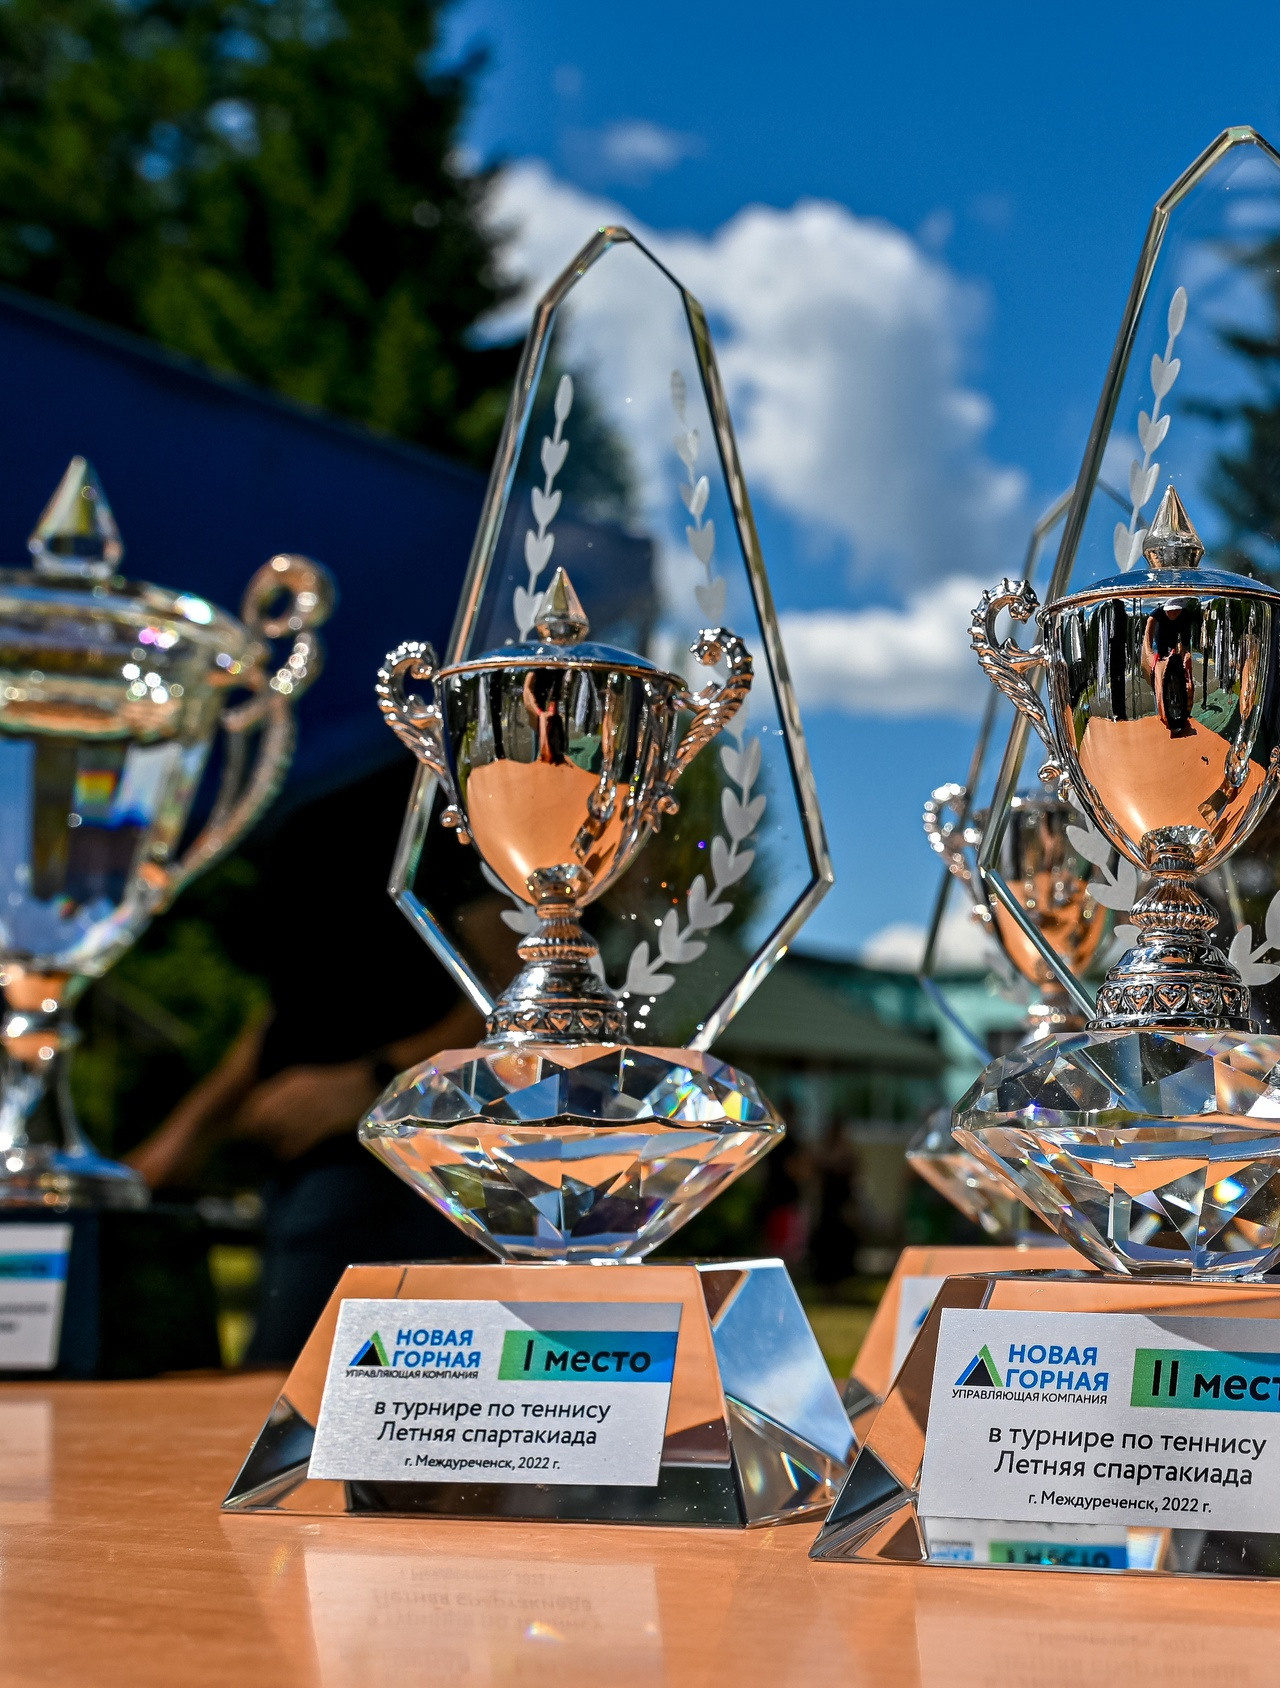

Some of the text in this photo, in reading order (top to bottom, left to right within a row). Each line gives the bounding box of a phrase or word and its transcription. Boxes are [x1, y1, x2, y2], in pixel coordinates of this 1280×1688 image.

[395, 1329, 474, 1347] НОВАЯ
[391, 1350, 482, 1368] ГОРНАЯ
[523, 1339, 651, 1374] I место
[1007, 1343, 1098, 1366] НОВАЯ
[345, 1369, 479, 1380] УПРАВЛЯЮЩАЯ КОМПАНИЯ
[1005, 1368, 1109, 1392] ГОРНАЯ
[1151, 1360, 1179, 1397] II
[951, 1389, 1108, 1405] УПРАВЛЯЮЩАЯ КОМПАНИЯ
[374, 1402, 611, 1423] в турнире по теннису
[377, 1421, 597, 1448] Летняя спартакиада
[988, 1428, 1267, 1460] в турнире по теннису
[404, 1455, 561, 1471] г. Междуреченск, 2022 г.
[994, 1451, 1252, 1487] Летняя спартакиада
[1028, 1491, 1212, 1513] г. Междуреченск, 2022 г.
